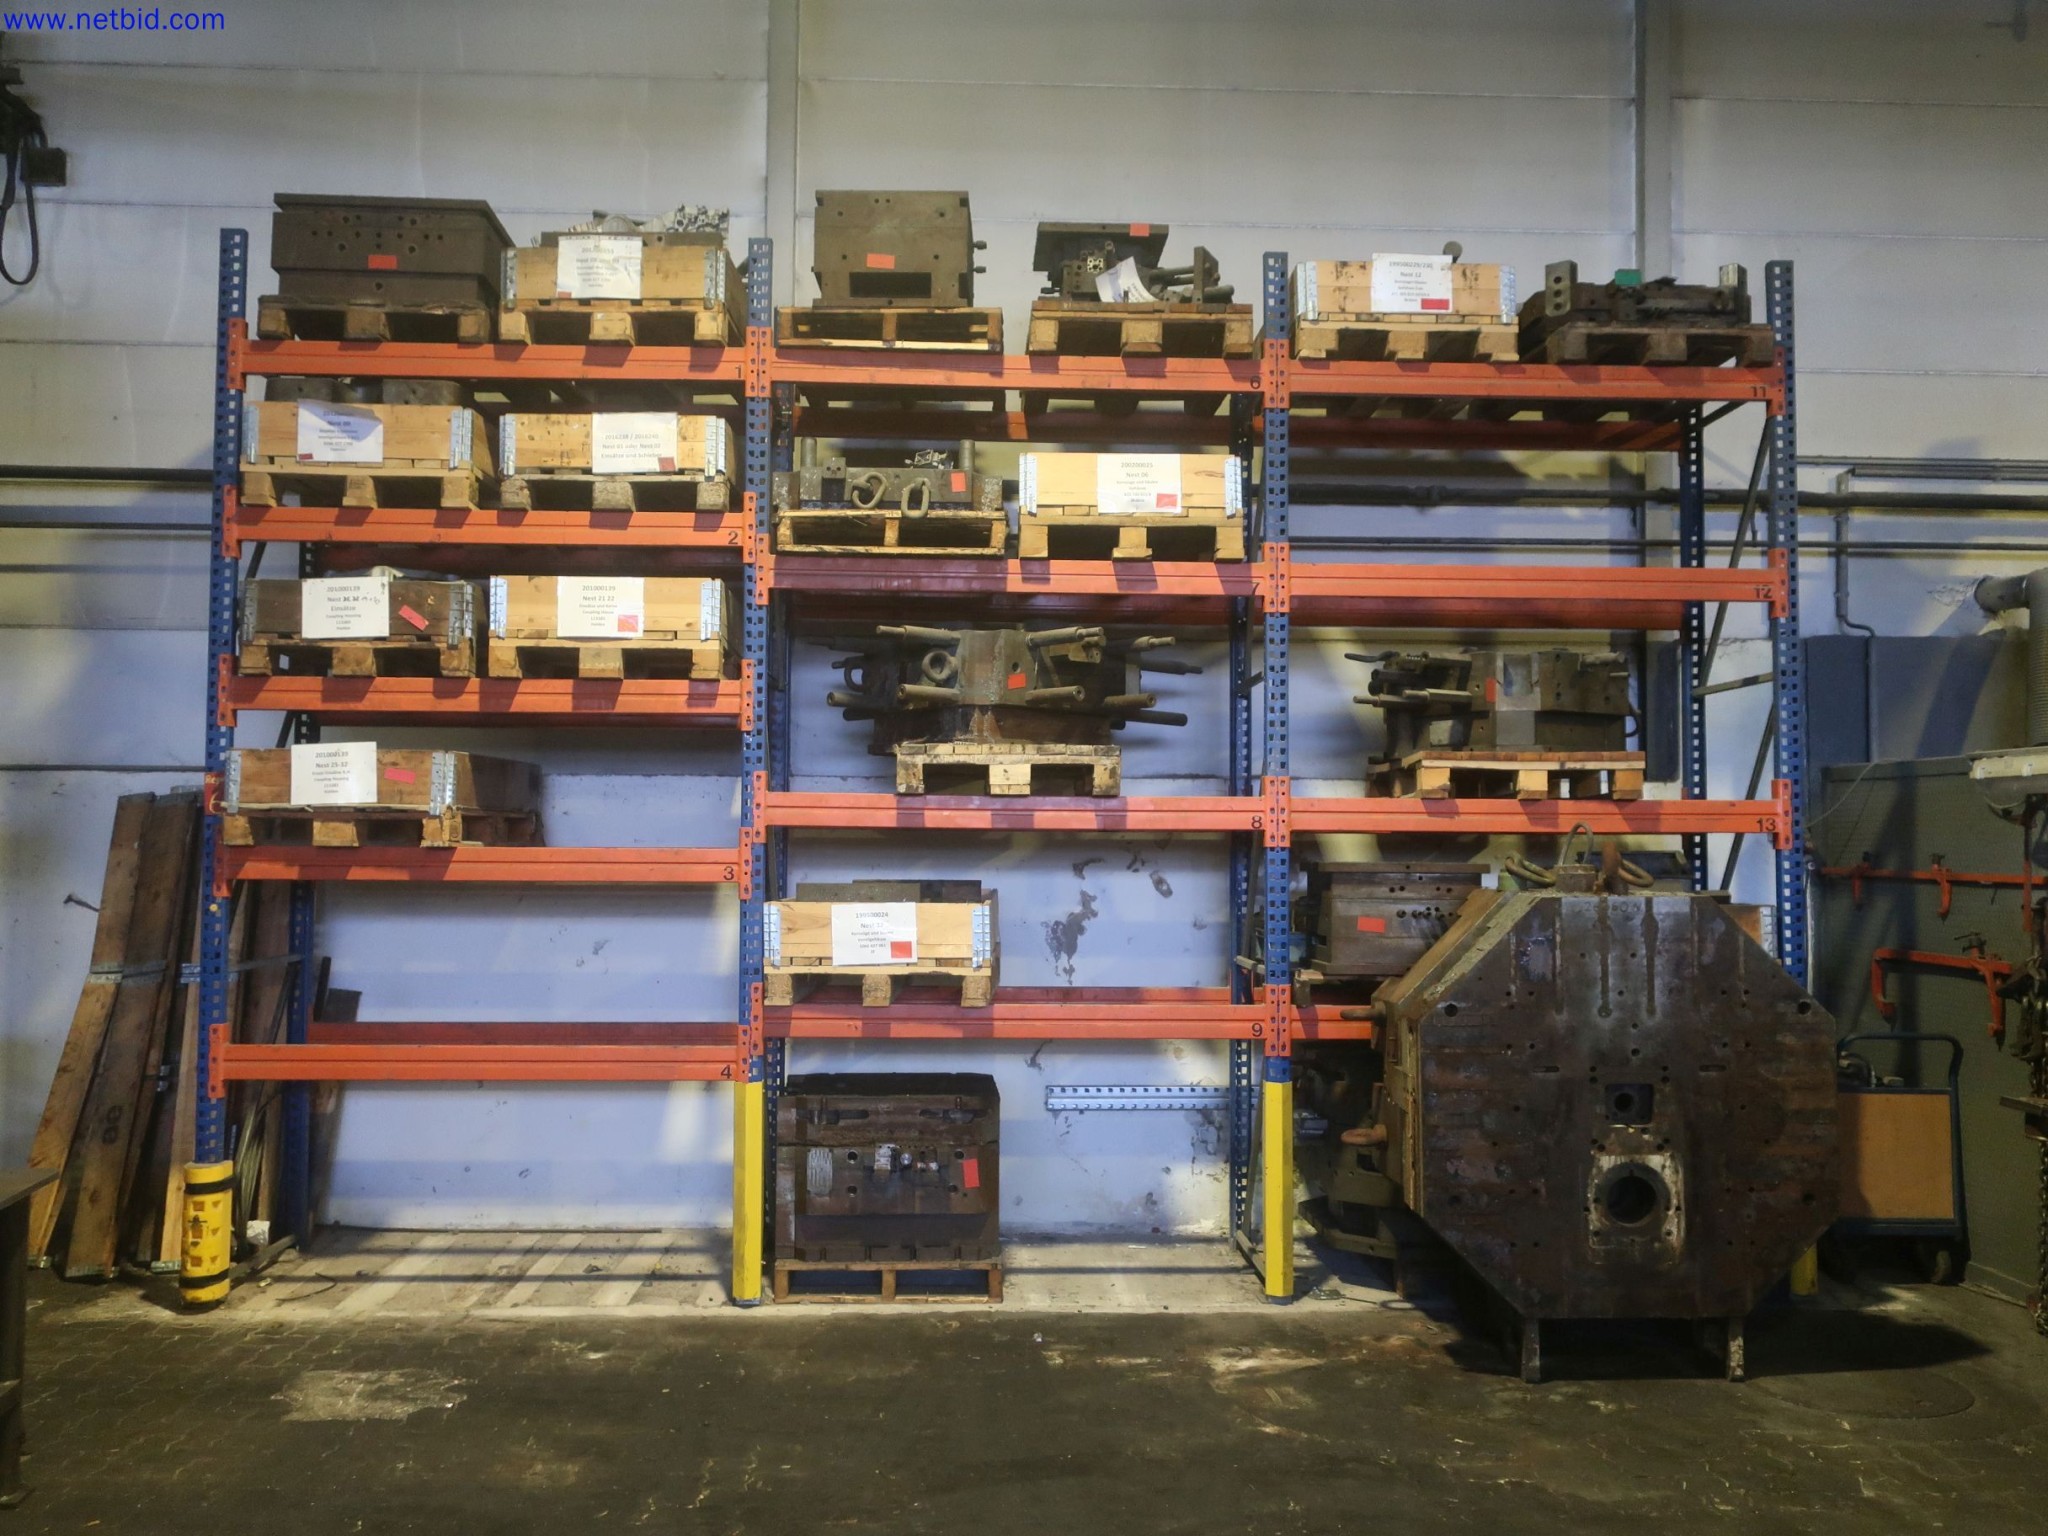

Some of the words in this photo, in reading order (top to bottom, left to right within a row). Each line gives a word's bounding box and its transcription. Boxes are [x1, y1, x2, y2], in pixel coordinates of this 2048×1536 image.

[1250, 374, 1262, 390] 6
[727, 530, 739, 545] 2
[1753, 584, 1773, 599] 12
[1251, 815, 1263, 829] 8
[1755, 817, 1777, 832] 13
[723, 865, 735, 881] 3
[1251, 1022, 1264, 1038] 9
[720, 1064, 733, 1080] 4
